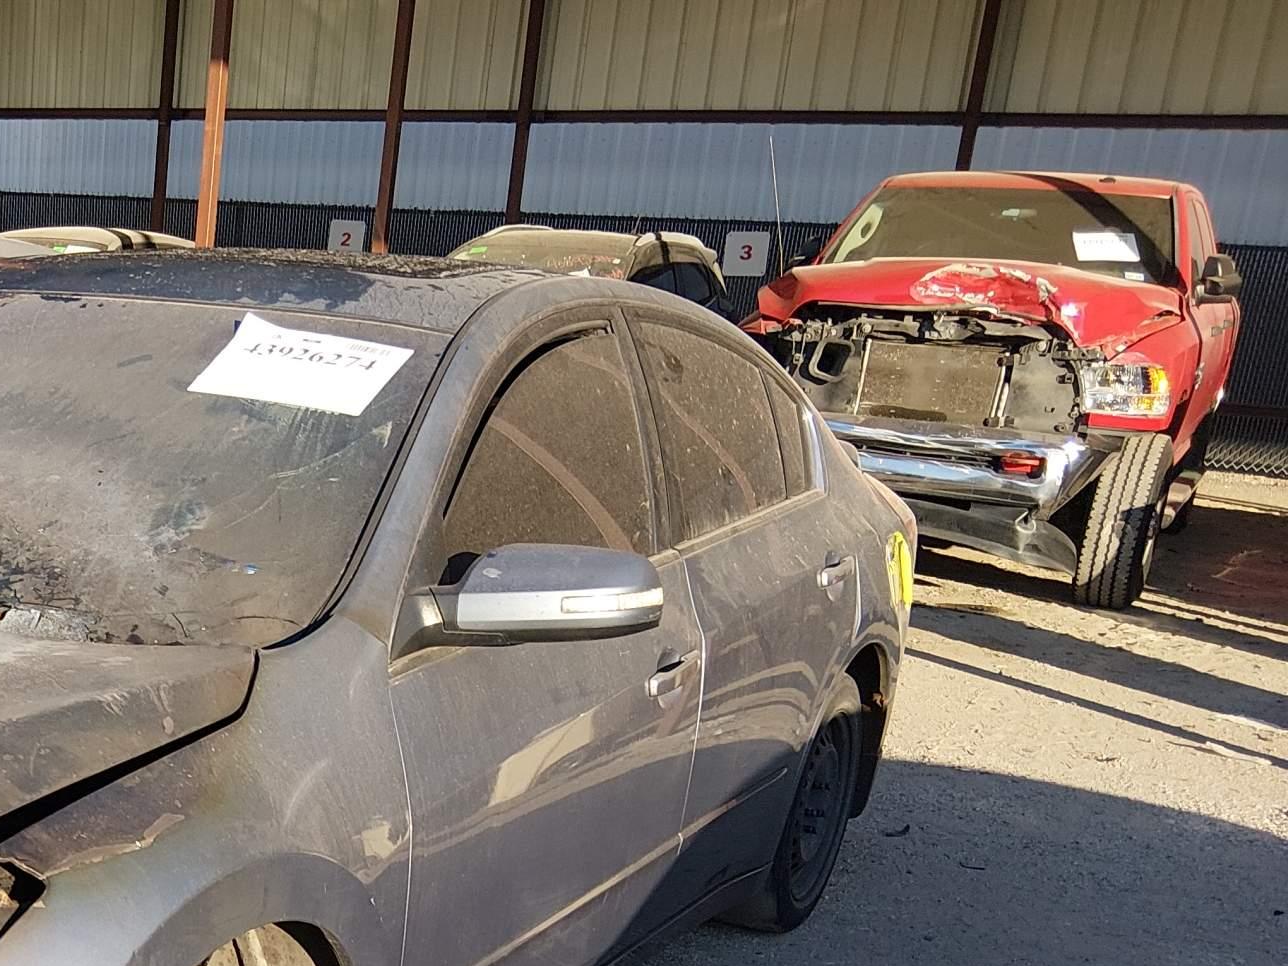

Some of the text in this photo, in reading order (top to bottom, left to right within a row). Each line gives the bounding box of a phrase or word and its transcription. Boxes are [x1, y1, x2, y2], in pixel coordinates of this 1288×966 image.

[340, 232, 352, 247] 2
[739, 244, 753, 261] 3
[243, 342, 377, 372] 43926274
